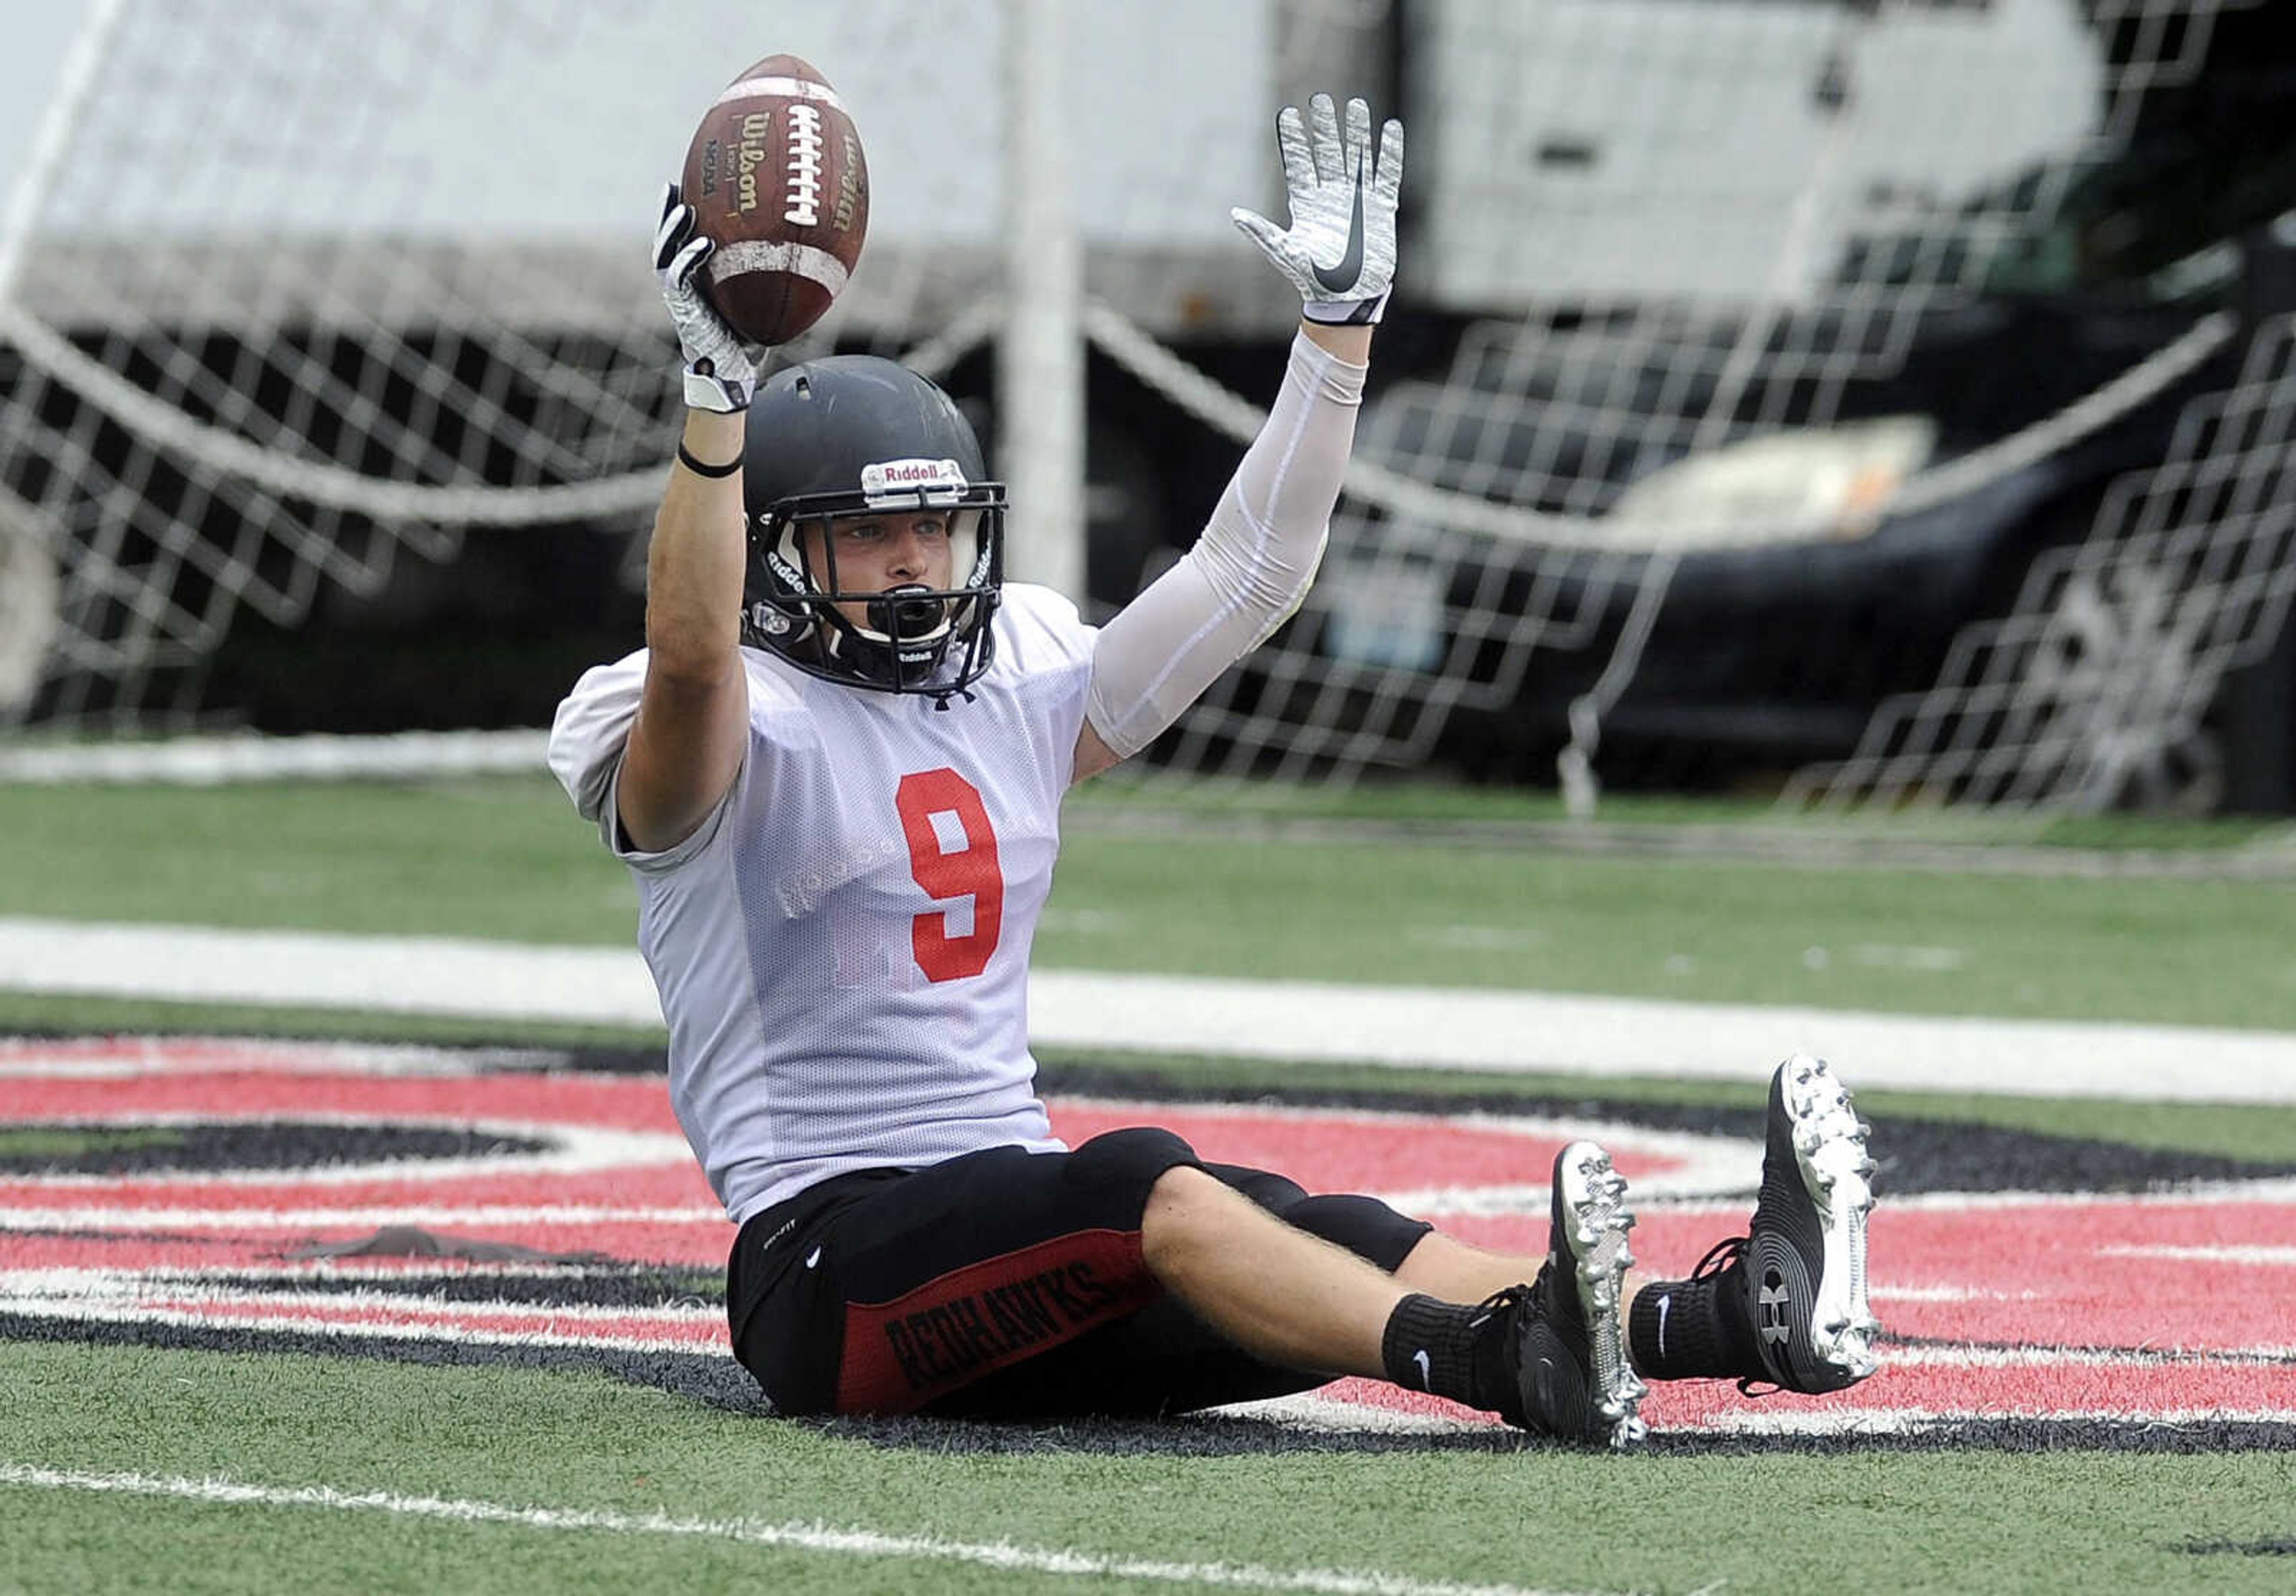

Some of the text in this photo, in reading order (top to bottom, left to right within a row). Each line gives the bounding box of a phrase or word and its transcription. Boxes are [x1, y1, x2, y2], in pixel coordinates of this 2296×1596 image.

[740, 112, 770, 213] Wilson
[885, 464, 938, 482] Riddell
[894, 767, 1004, 983] 9
[884, 1262, 1119, 1391] REDHAWKS
